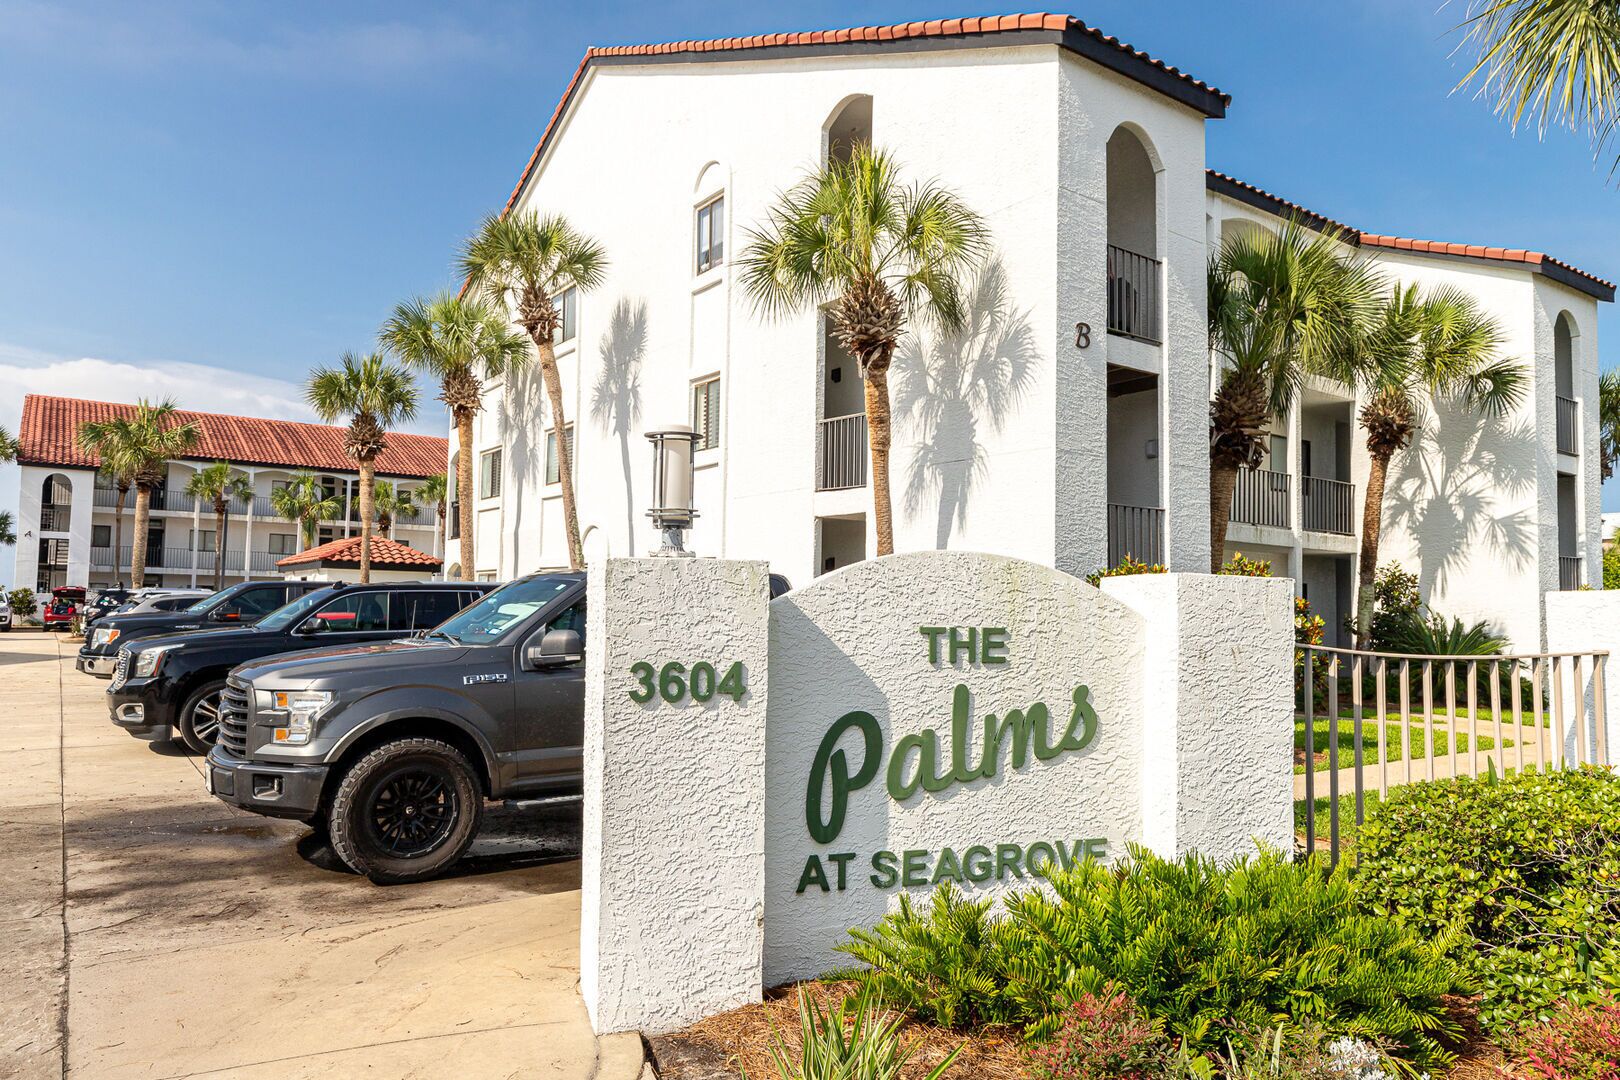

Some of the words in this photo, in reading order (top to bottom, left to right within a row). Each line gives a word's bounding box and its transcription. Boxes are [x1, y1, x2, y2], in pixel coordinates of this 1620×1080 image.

[1075, 322, 1091, 349] B
[919, 626, 1007, 664] THE
[628, 661, 745, 704] 3604
[805, 684, 1098, 844] Palms
[796, 852, 856, 894] AT
[870, 837, 1108, 888] SEAGROVE
